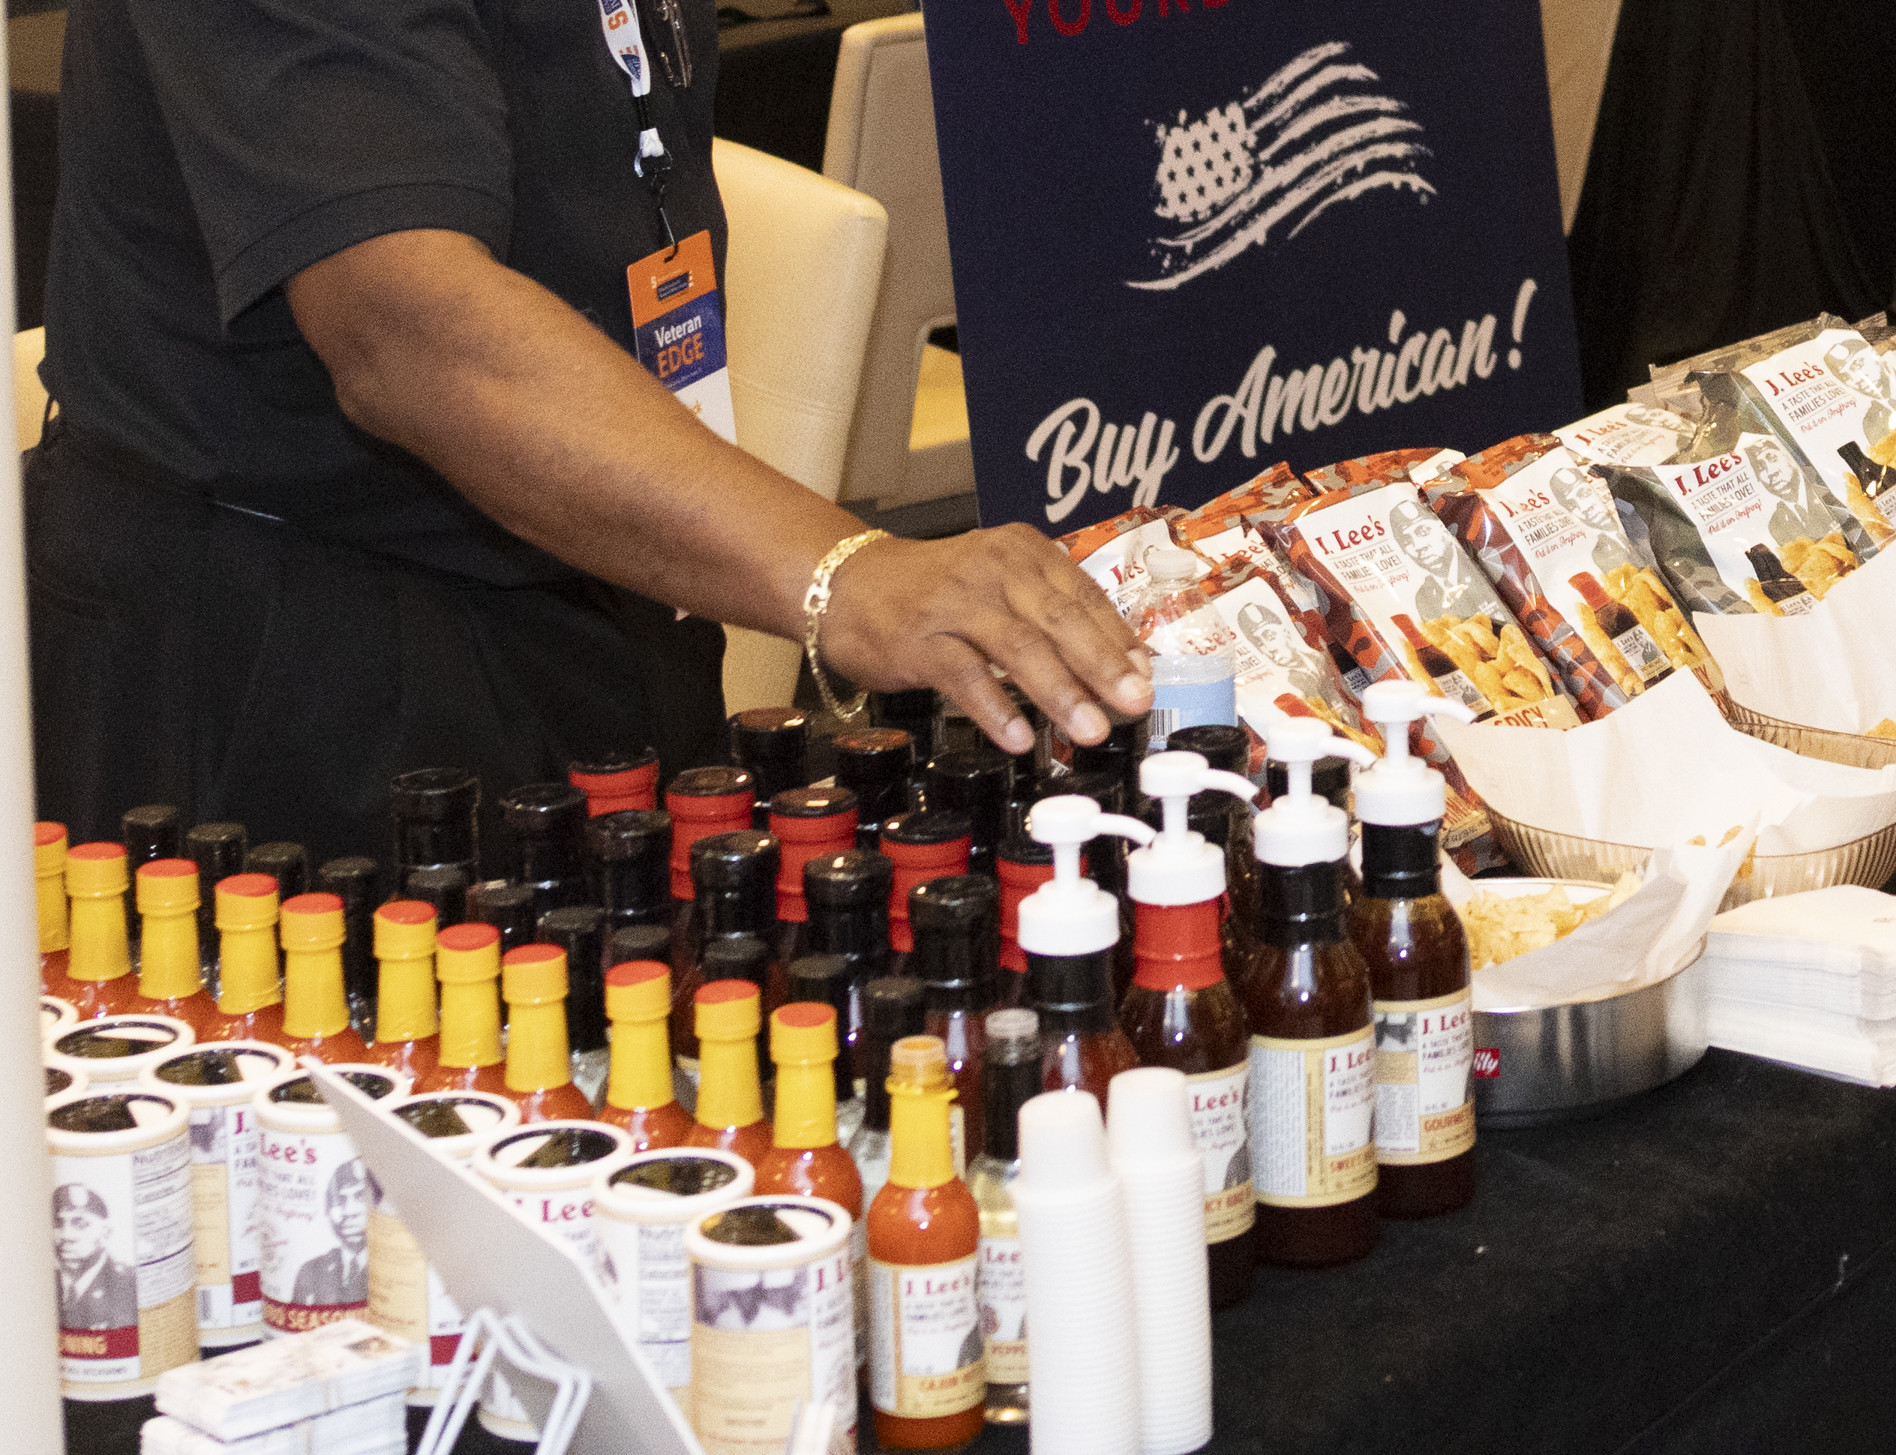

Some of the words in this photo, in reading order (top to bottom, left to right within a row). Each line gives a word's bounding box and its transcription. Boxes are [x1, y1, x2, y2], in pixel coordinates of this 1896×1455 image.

[654, 315, 703, 348] Veteran
[656, 332, 706, 380] EDGE
[1764, 378, 1784, 397] J.
[1778, 361, 1824, 388] Lee's
[1025, 397, 1181, 525] Buy
[1191, 278, 1538, 462] American!
[1780, 401, 1789, 411] A
[1787, 389, 1811, 407] TASTE
[1787, 394, 1827, 422] FAMILIES
[1673, 474, 1692, 496] J.
[1715, 479, 1736, 496] THAT
[1734, 471, 1750, 484] ALL
[1730, 482, 1756, 504] OVE!
[1516, 488, 1550, 513] ee's
[1331, 514, 1386, 551] Lee's
[1523, 521, 1560, 546] FAMILIES
[1379, 543, 1395, 555] ALL
[1340, 564, 1374, 583] FAMILIE
[1474, 1051, 1500, 1075] illy
[1193, 1084, 1240, 1113] Lee's
[234, 1111, 250, 1135] J.
[260, 1133, 317, 1165] Lee's
[541, 1198, 597, 1224] Lee
[985, 1247, 1021, 1263] Lee
